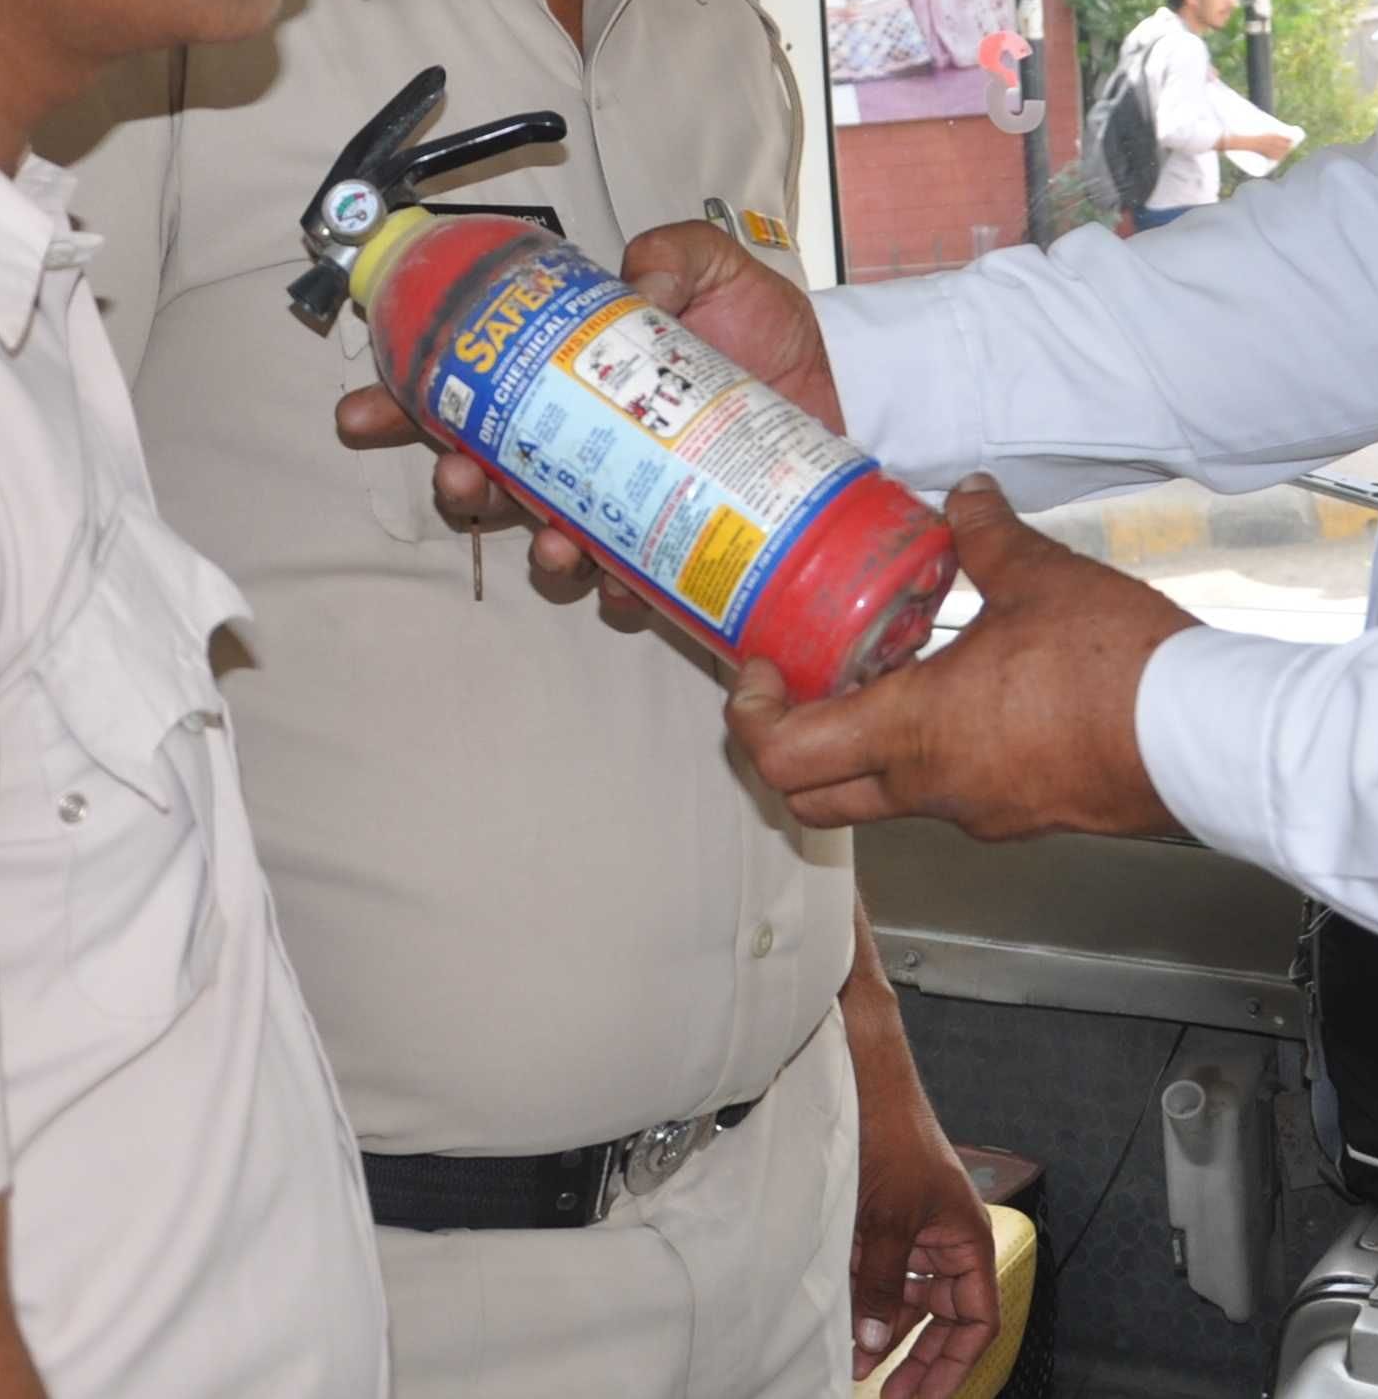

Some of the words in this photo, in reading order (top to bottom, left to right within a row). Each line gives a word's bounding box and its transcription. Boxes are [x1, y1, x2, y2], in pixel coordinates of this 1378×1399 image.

[479, 404, 502, 444] DRY
[493, 313, 569, 406] CHEMICAL
[557, 469, 576, 489] B
[601, 501, 622, 524] C
